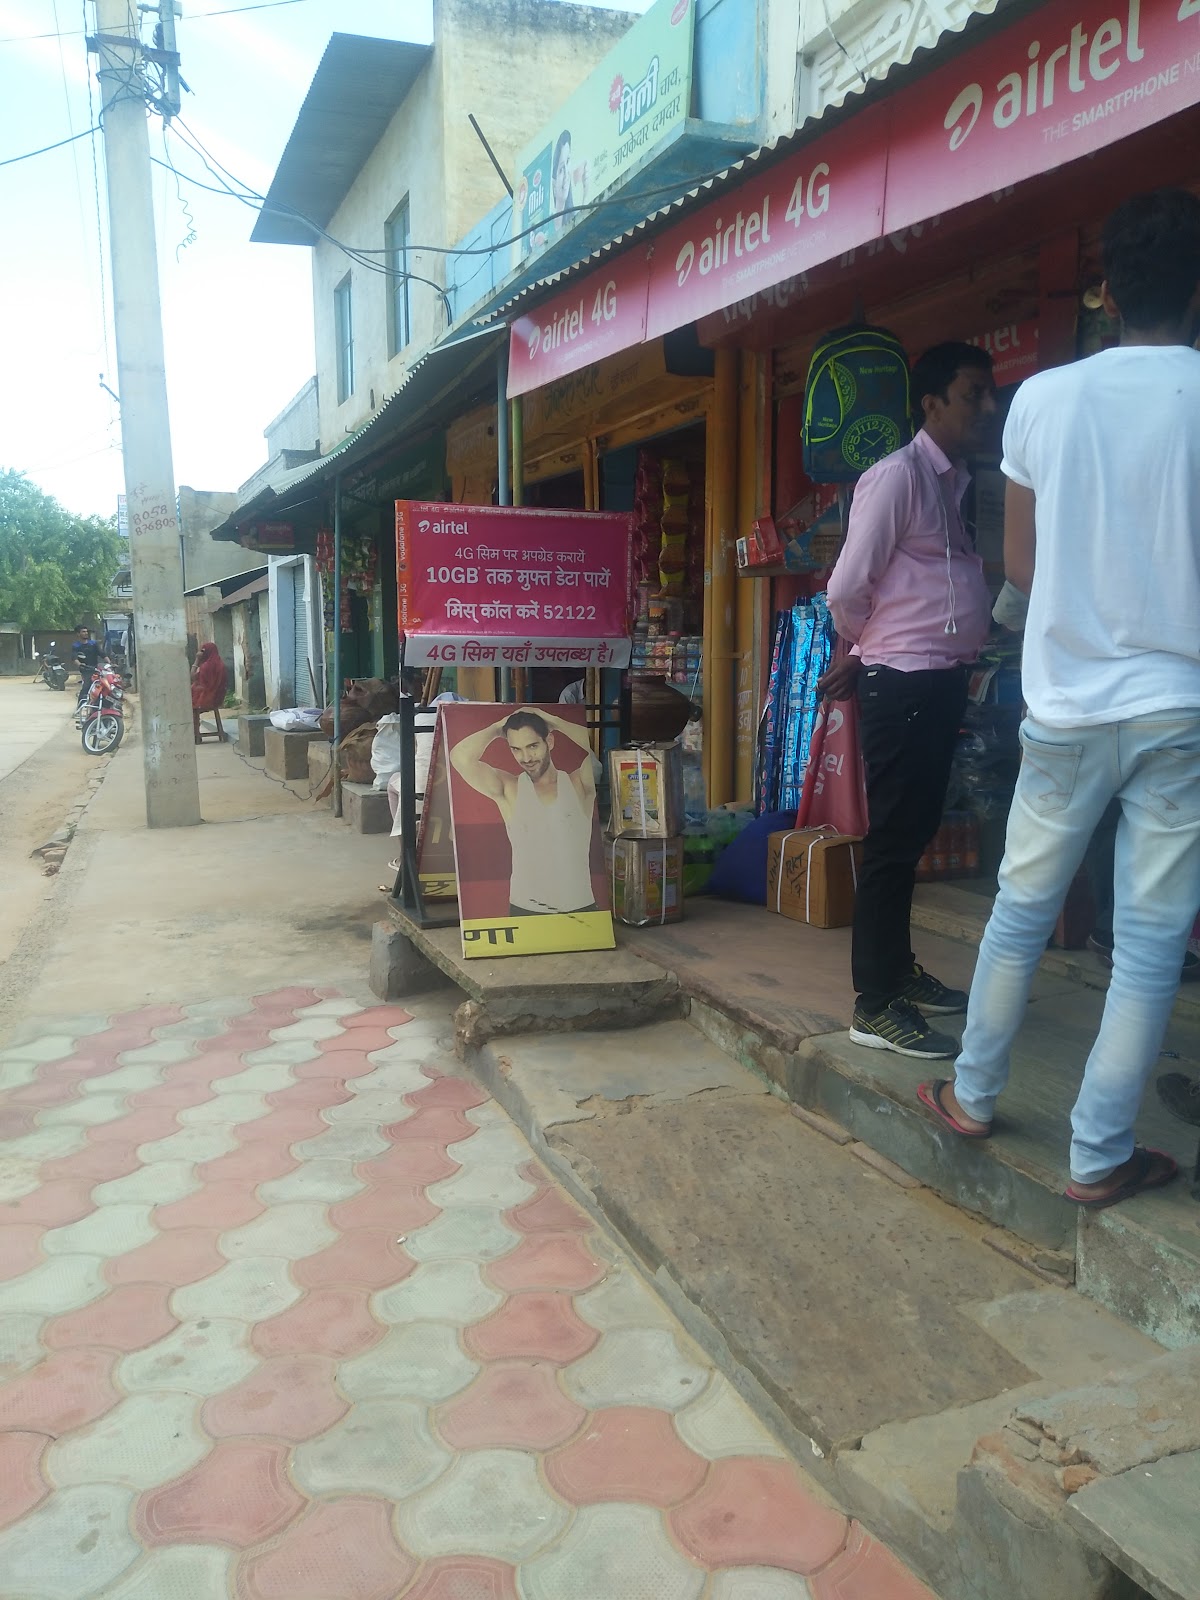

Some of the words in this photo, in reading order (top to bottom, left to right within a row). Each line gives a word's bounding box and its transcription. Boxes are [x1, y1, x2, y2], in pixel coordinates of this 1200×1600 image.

[992, 0, 1145, 129] airtel
[619, 55, 659, 134] मिली
[1042, 119, 1069, 144] THE
[1072, 63, 1180, 132] SMARTPHONE
[652, 93, 682, 132] दमदार
[699, 195, 771, 276] airtel
[785, 162, 830, 228] 4G
[736, 247, 787, 283] SMARTPHONE
[542, 299, 584, 353] airtel
[591, 280, 617, 327] 4G
[133, 505, 167, 525] 8058
[135, 517, 176, 536] 876805
[397, 511, 403, 521] 3G
[432, 520, 469, 535] airtel
[454, 547, 474, 560] 4G
[476, 544, 500, 560] सिम
[502, 549, 518, 561] पर
[522, 547, 553, 562] अपग्रेड
[556, 548, 586, 563] करायें
[485, 567, 513, 585] तक
[516, 568, 552, 591] मुफ्त
[555, 565, 580, 587] डेटा
[583, 567, 611, 588] पायें
[479, 600, 513, 619] कॉल
[515, 599, 541, 620] करें
[543, 604, 596, 620] 52122
[426, 644, 457, 662] 4G
[461, 640, 499, 662] सिम
[502, 640, 533, 662] यहाँ
[535, 647, 594, 663] उपलब्ध
